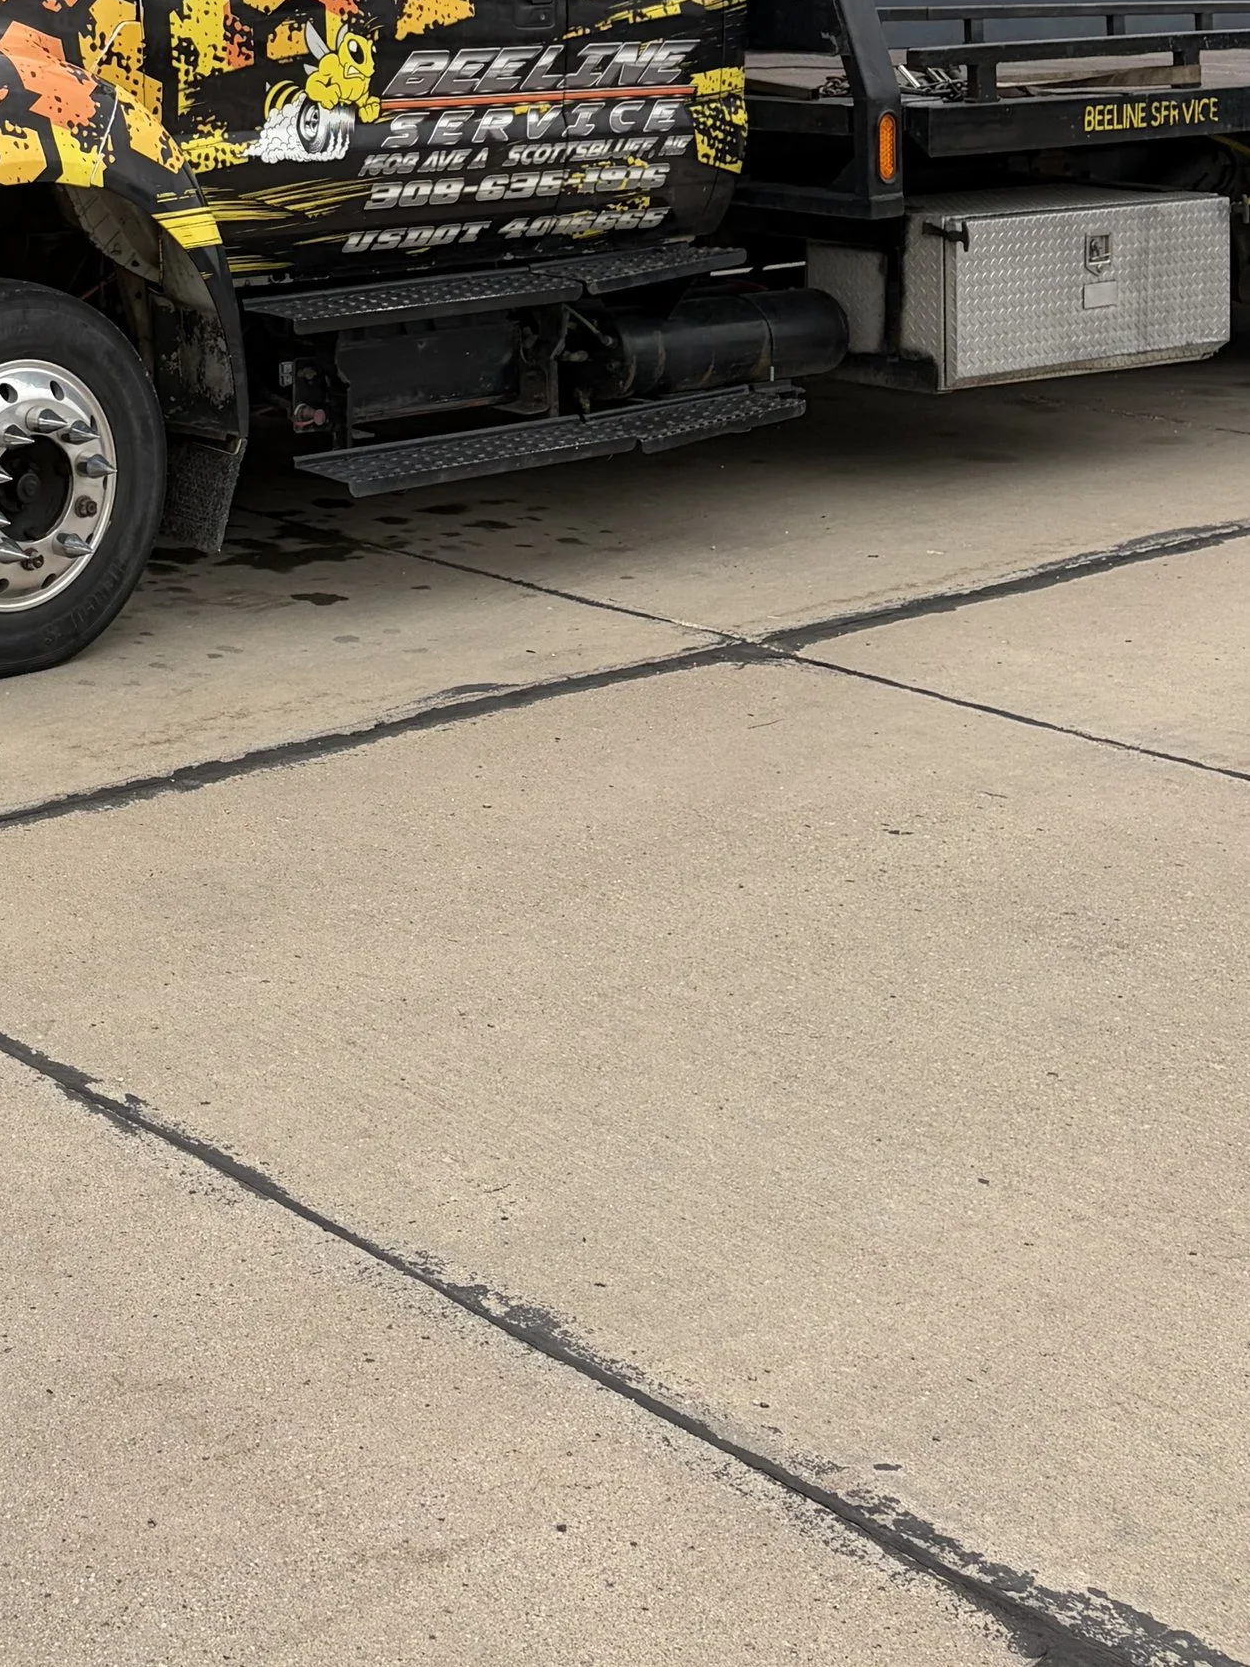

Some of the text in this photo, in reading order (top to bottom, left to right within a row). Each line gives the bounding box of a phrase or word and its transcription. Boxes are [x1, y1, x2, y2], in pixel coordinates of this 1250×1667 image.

[382, 39, 700, 97] BEELINE
[381, 100, 687, 149] SERVICE
[1084, 102, 1147, 132] BEELINE
[417, 148, 472, 173] AVE
[467, 147, 489, 170] A
[341, 221, 492, 253] USDOT
